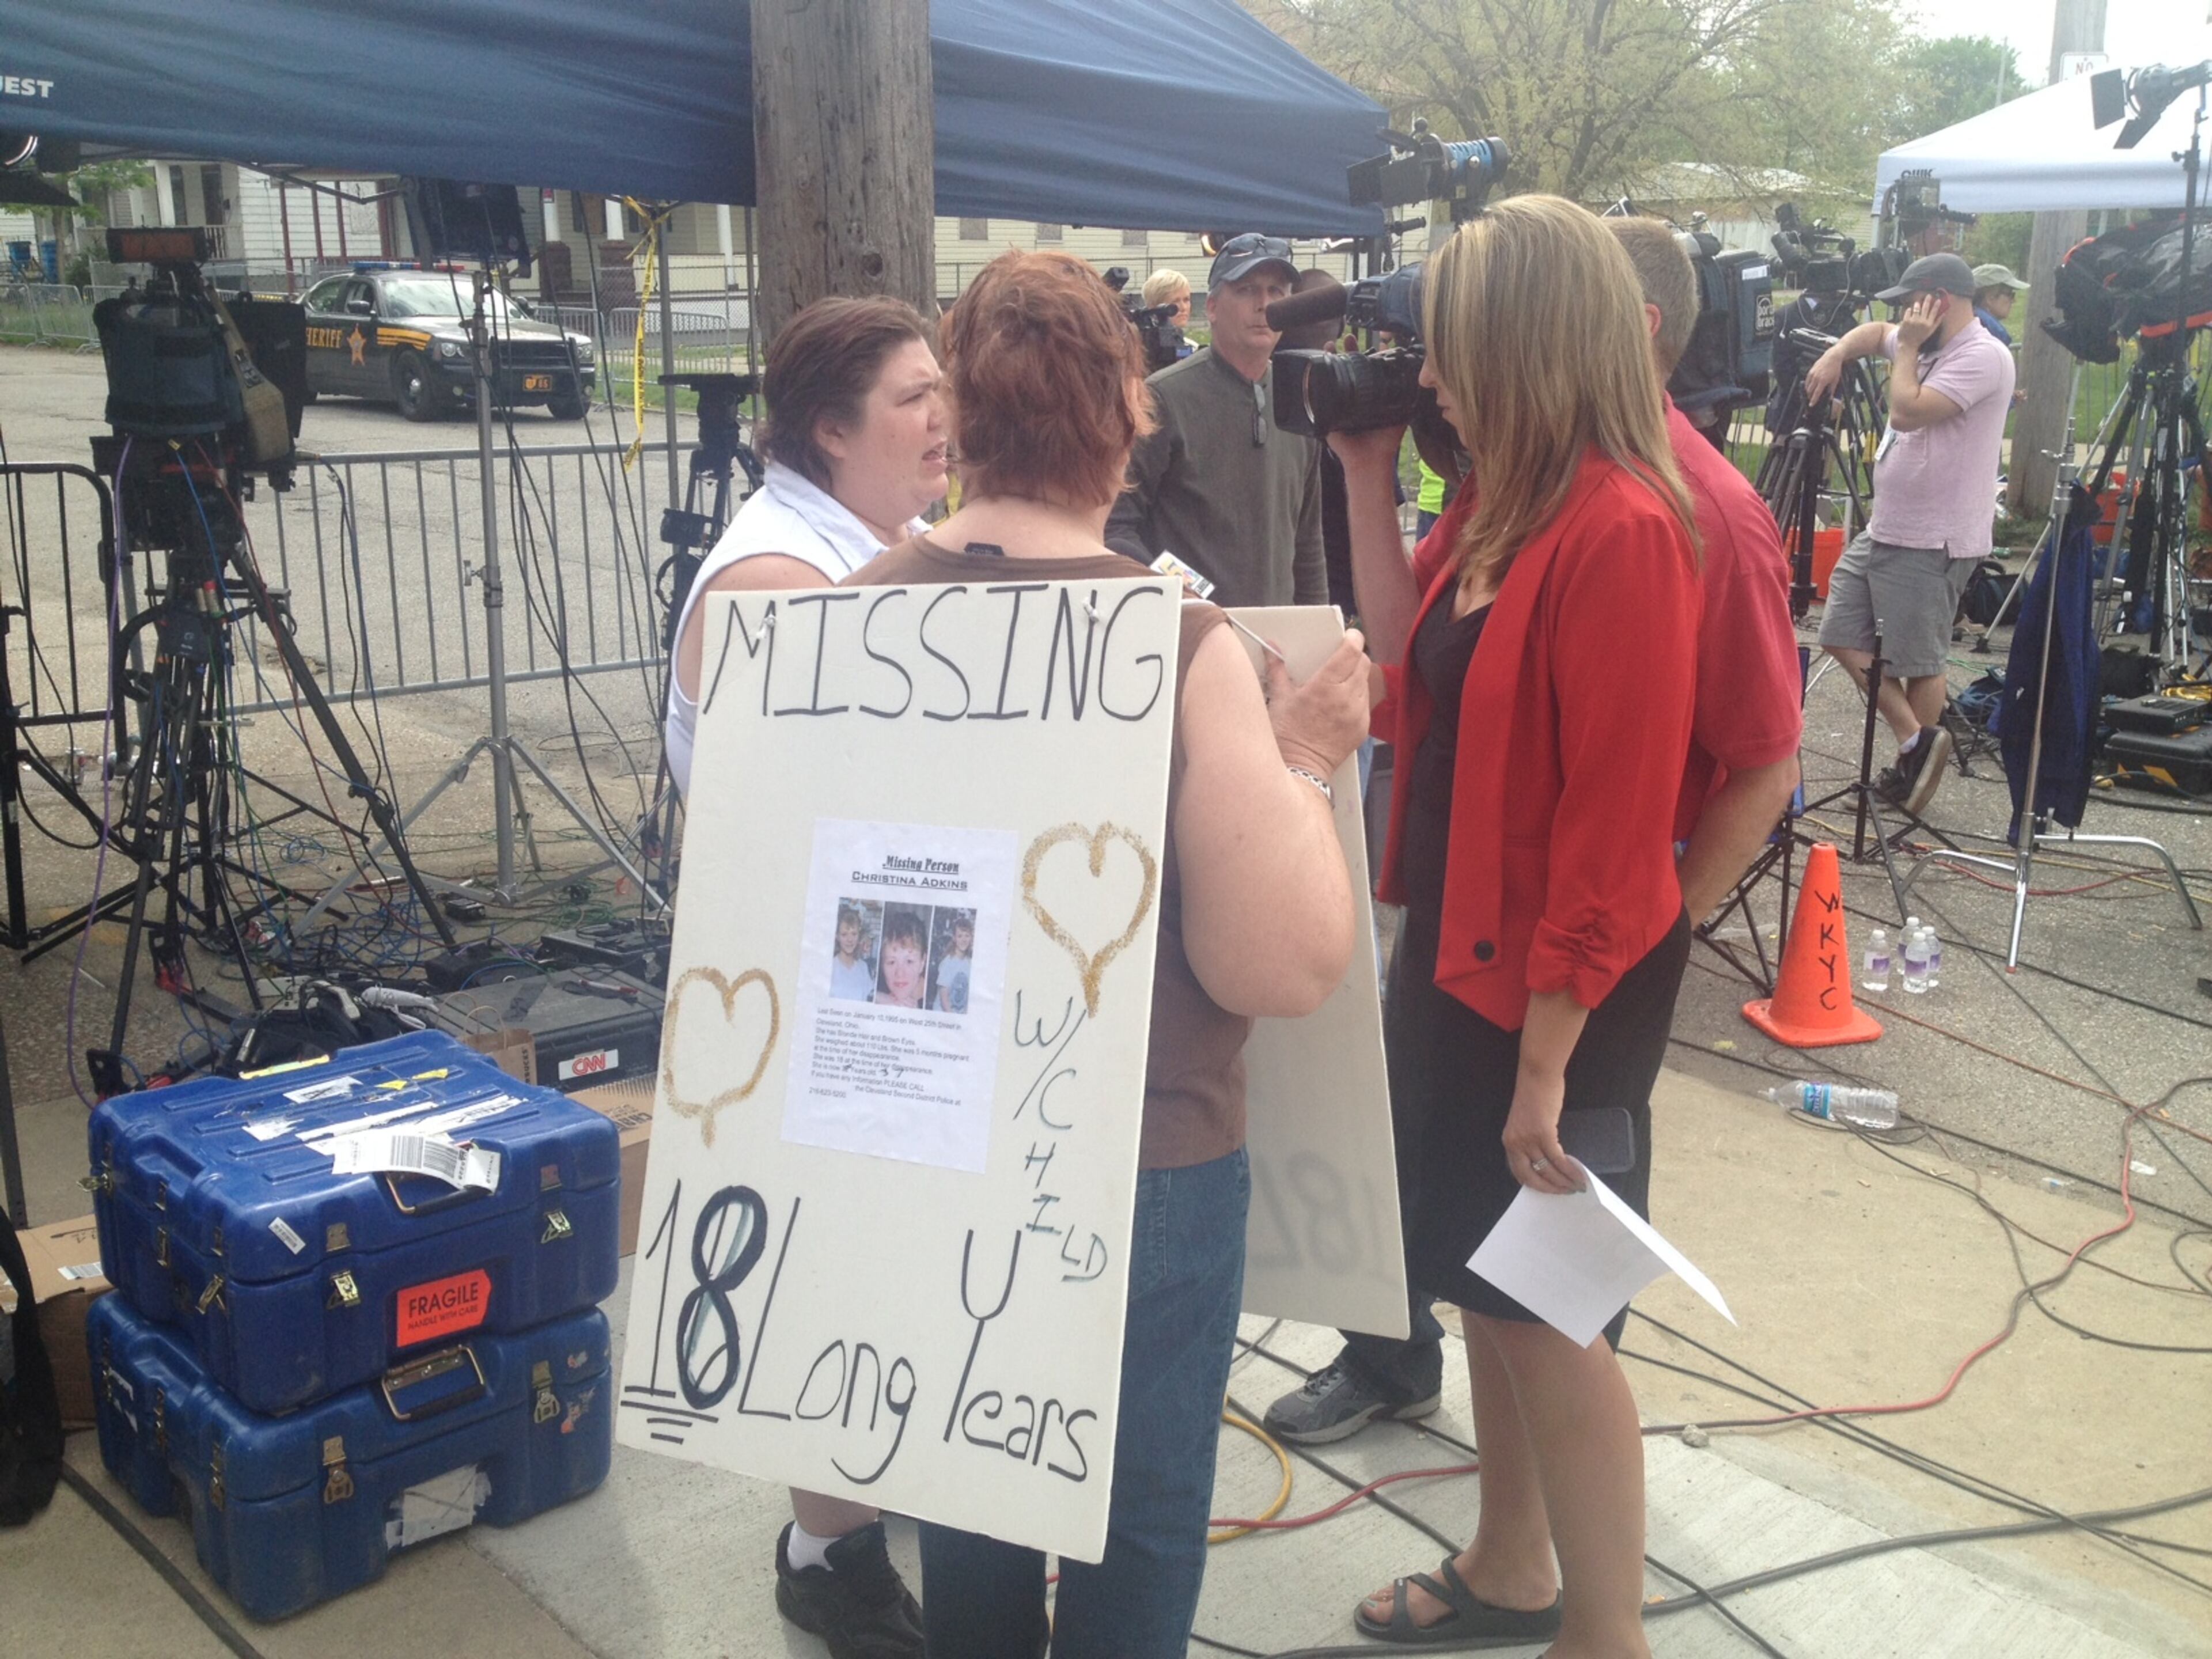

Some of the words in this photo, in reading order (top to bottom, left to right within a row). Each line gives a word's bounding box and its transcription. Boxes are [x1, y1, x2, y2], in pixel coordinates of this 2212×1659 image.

[306, 327, 342, 349] HERIFF
[702, 583, 1165, 722] MISSING
[885, 855, 923, 872] Missing
[925, 858, 959, 873] Person
[920, 877, 968, 890] ADKINS
[1815, 890, 1840, 1010] WKYC
[521, 1046, 531, 1085] RBUCKS
[572, 1054, 606, 1076] CNN
[408, 1282, 479, 1319] FRAGILE
[459, 1304, 478, 1317] CARE
[625, 1179, 768, 1410] 18
[737, 1197, 917, 1485] Long
[943, 1228, 1097, 1482] Years
